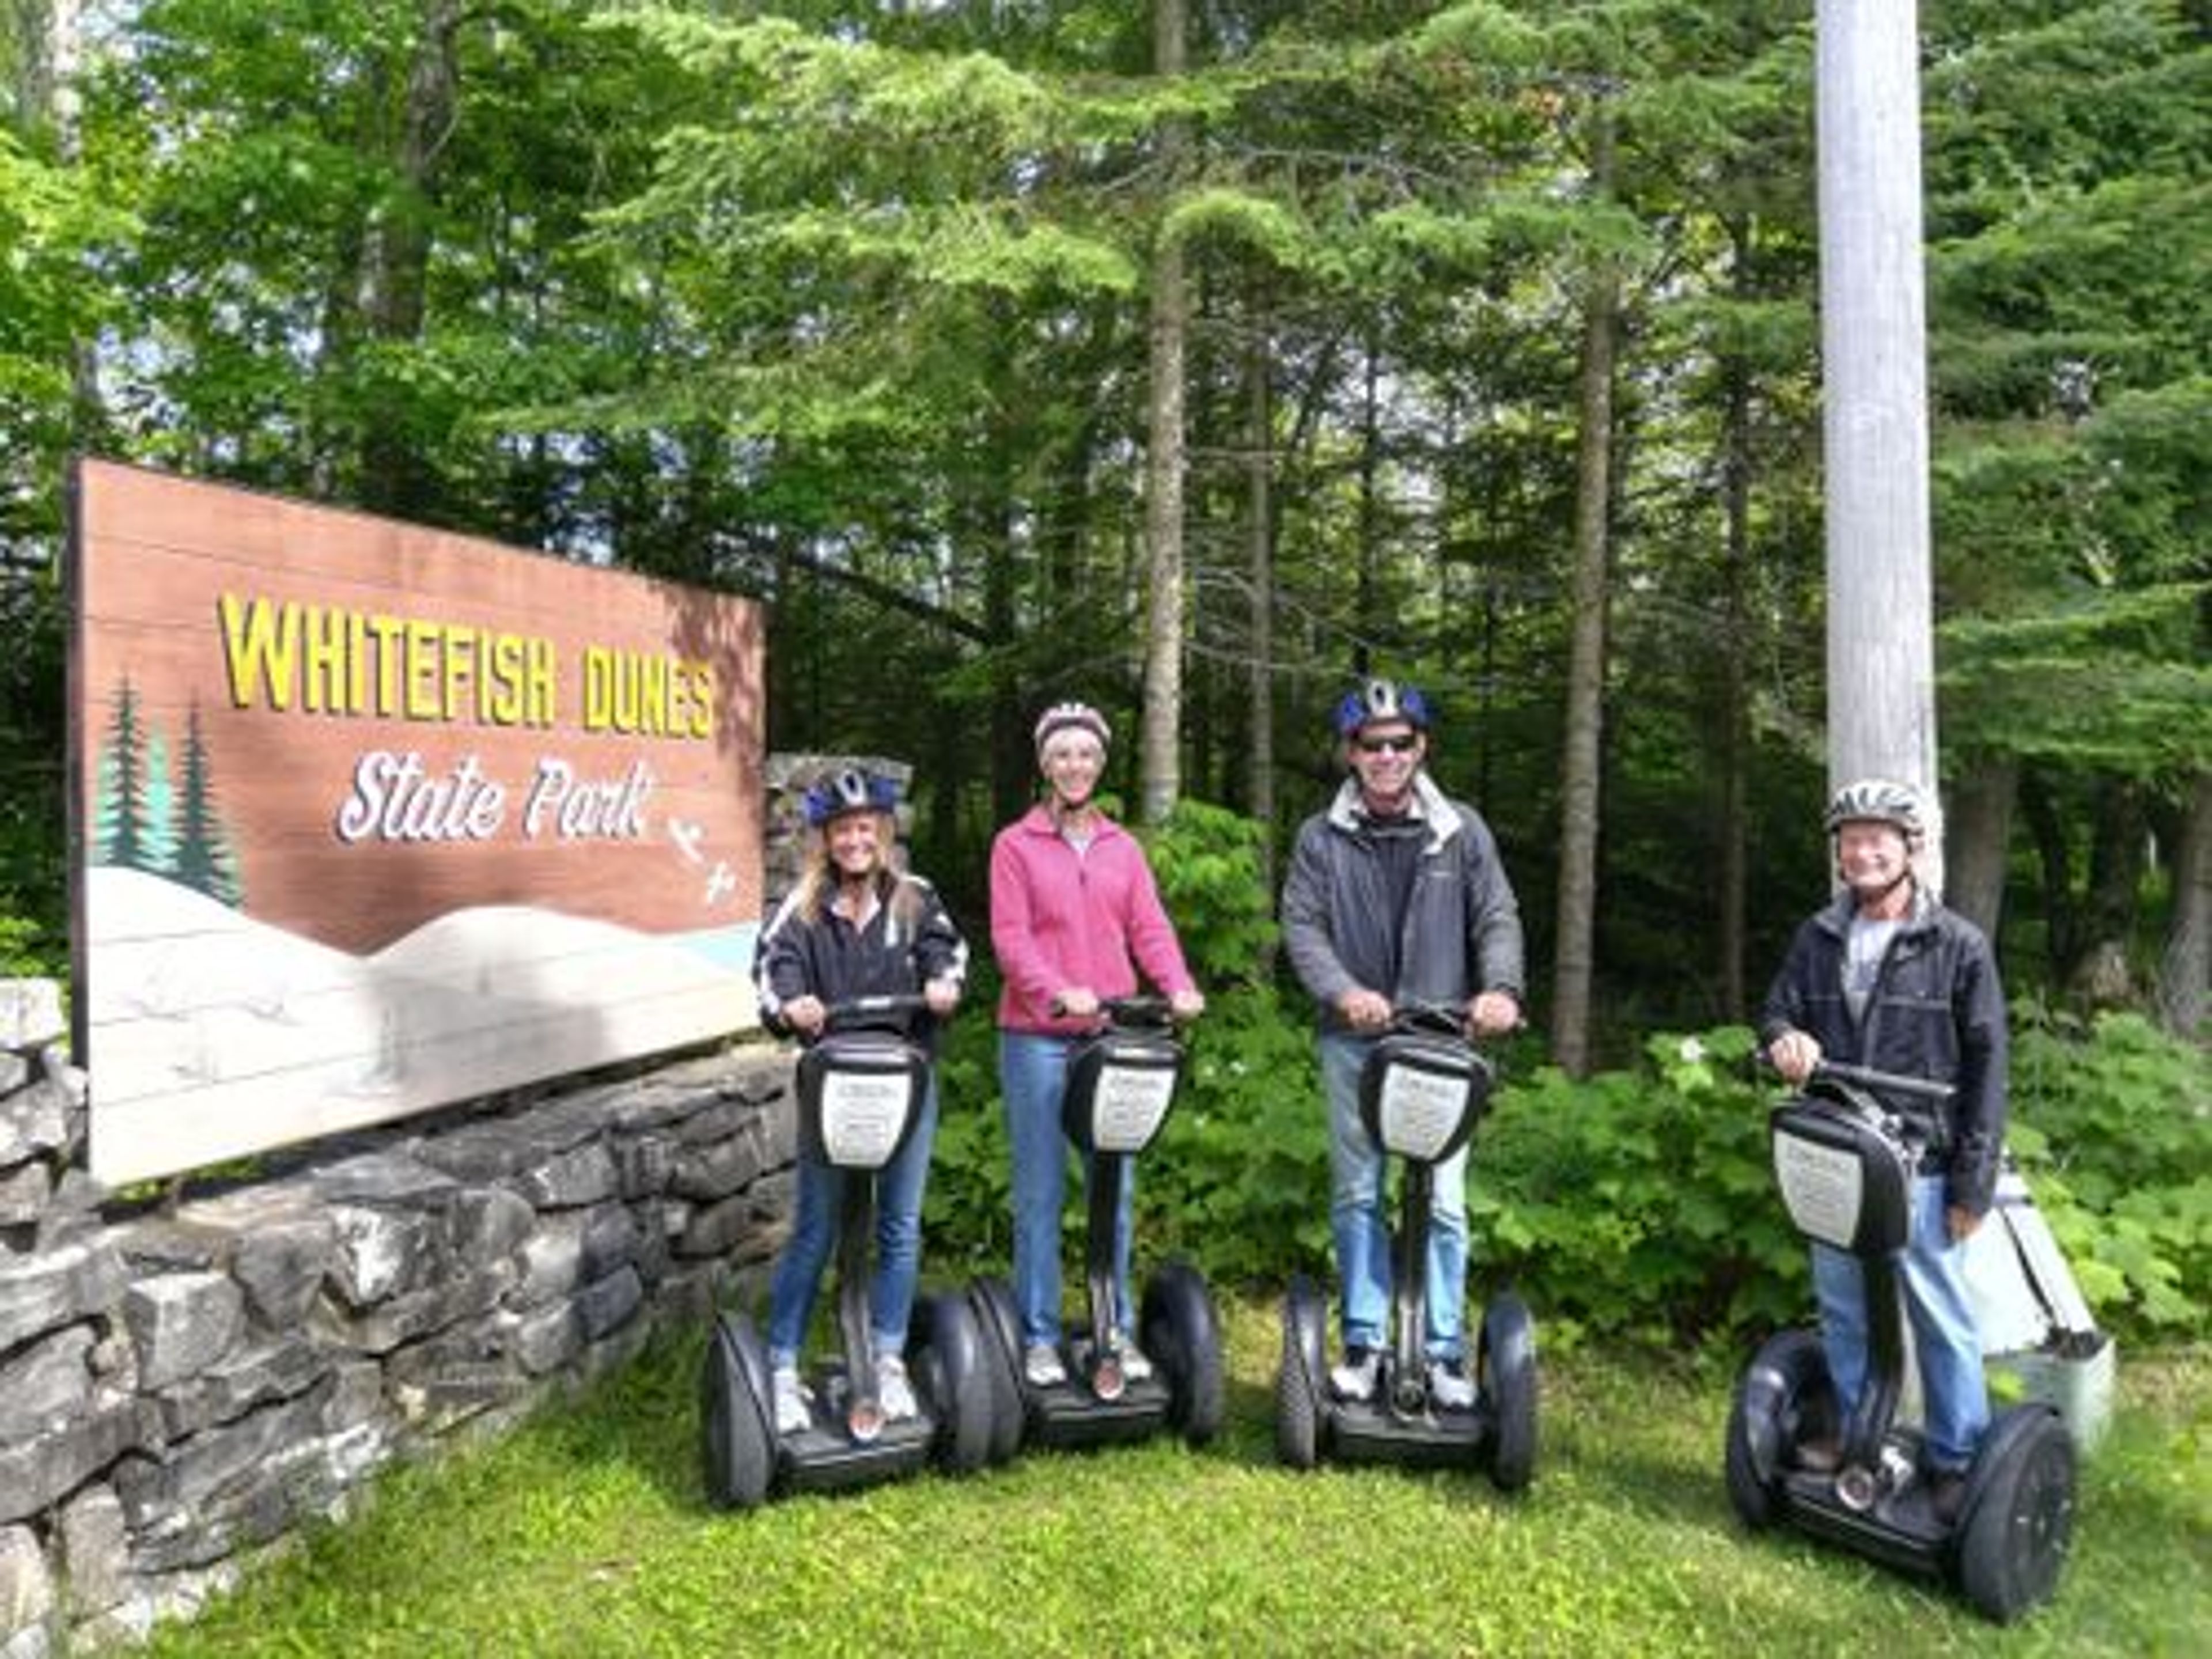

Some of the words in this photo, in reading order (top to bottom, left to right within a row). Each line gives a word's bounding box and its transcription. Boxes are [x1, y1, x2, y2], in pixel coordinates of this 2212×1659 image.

[218, 592, 556, 728] WHITEFISH
[583, 647, 715, 738] DUNES
[336, 751, 506, 844] State
[522, 757, 652, 839] Park
